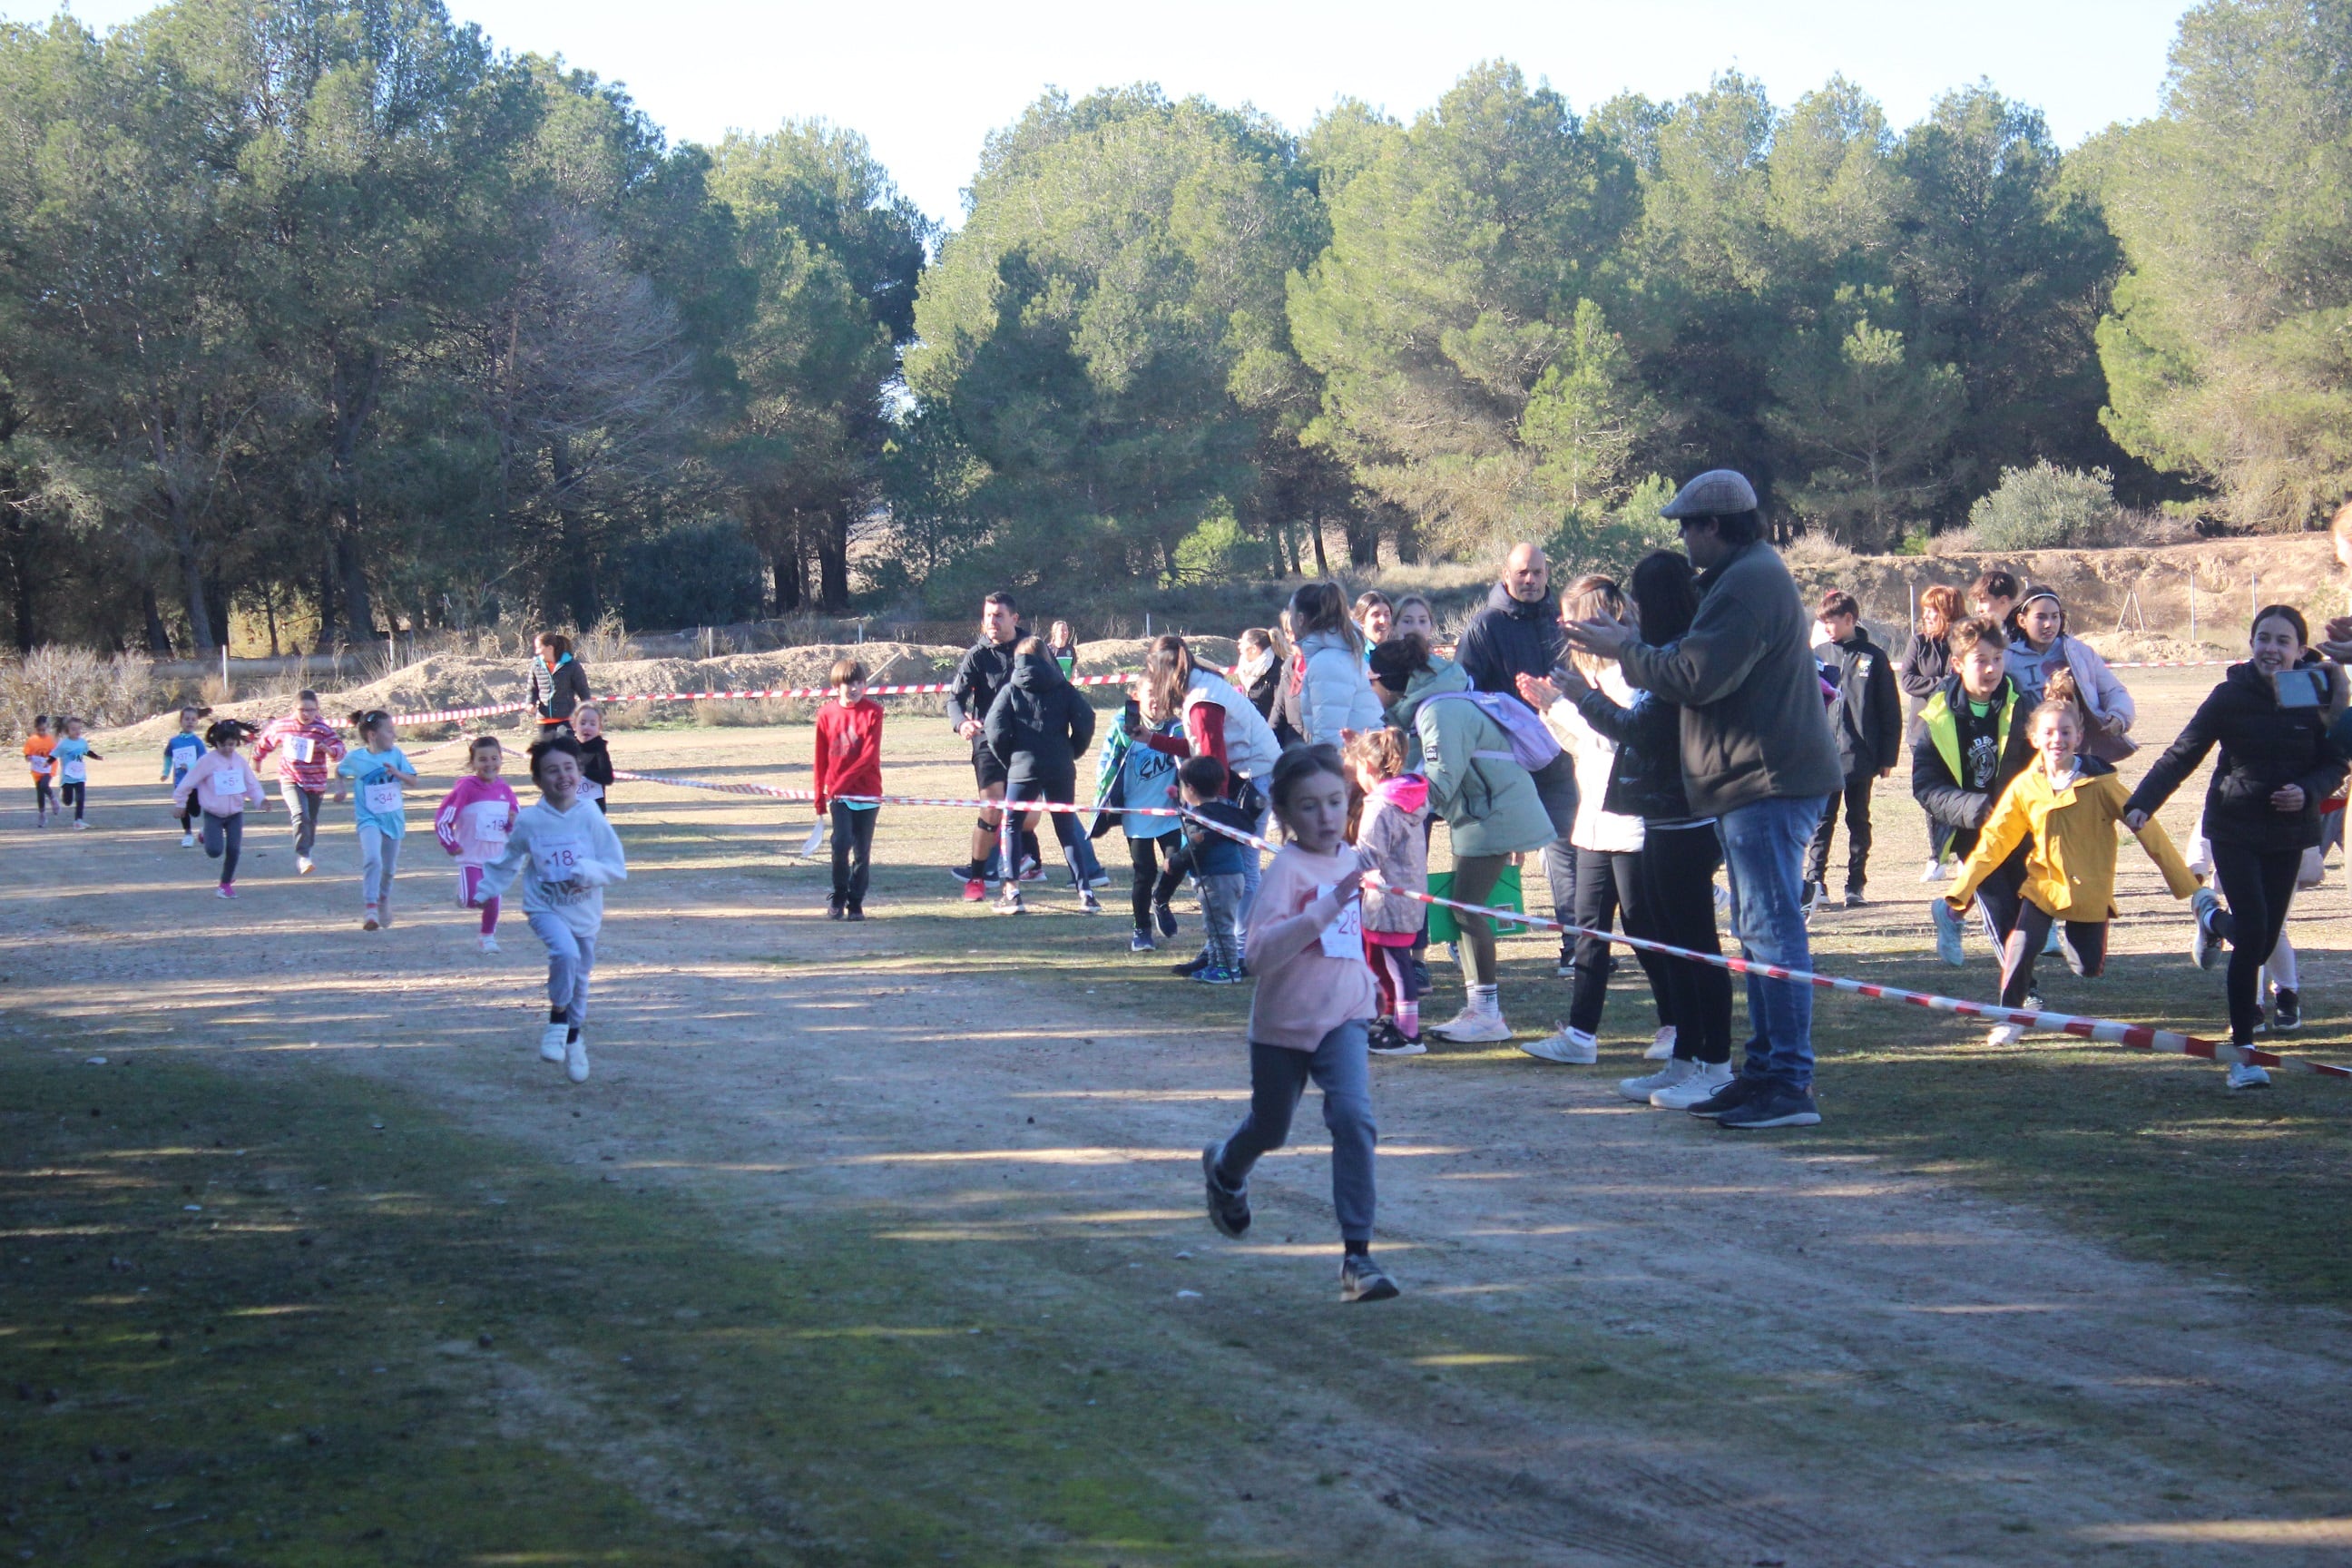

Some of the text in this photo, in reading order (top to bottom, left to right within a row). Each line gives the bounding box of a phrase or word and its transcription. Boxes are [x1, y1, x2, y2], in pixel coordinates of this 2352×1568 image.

[576, 783, 589, 794] 20
[379, 792, 393, 805] 34
[492, 819, 505, 831] 19
[552, 849, 573, 867] 18
[1338, 909, 1358, 936] 28
